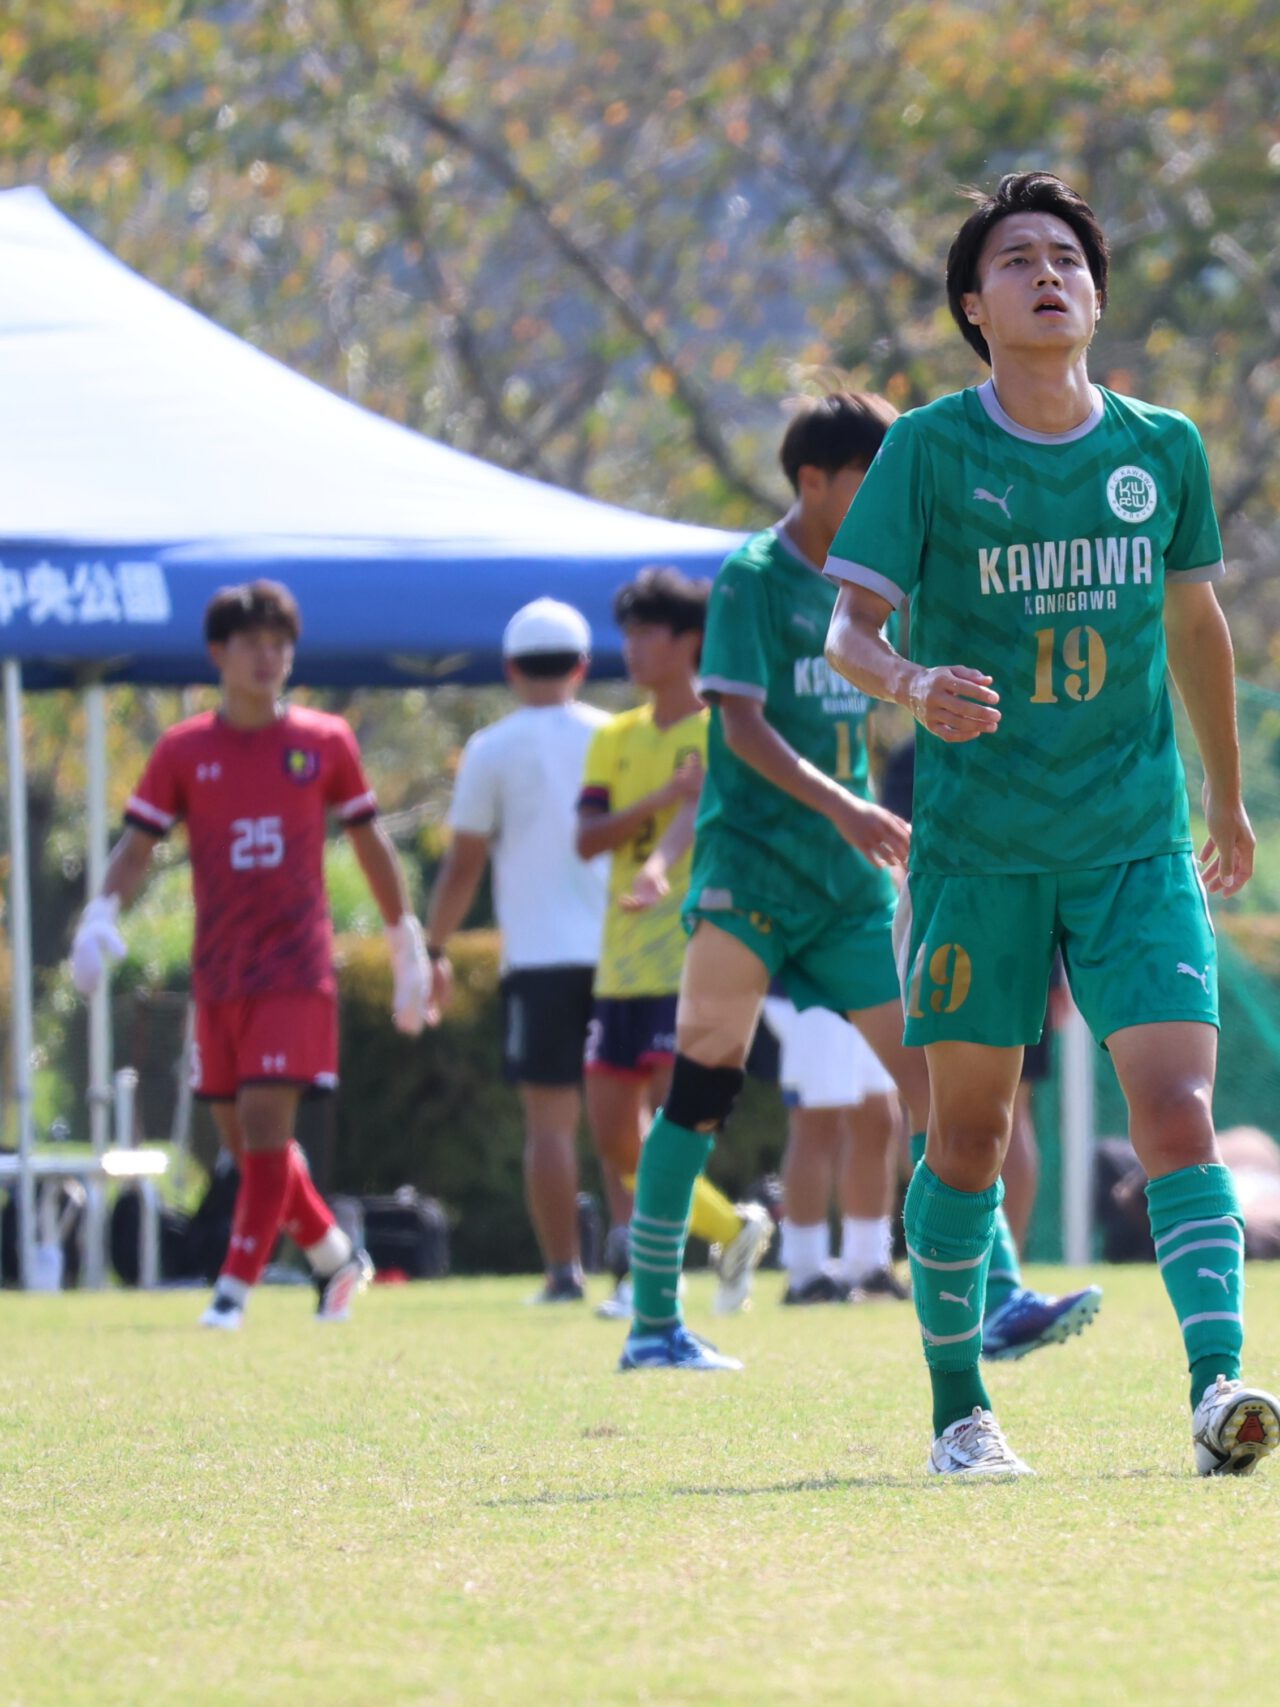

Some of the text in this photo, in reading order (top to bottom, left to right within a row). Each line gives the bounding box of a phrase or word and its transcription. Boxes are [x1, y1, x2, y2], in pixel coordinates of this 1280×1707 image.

[978, 536, 1152, 595] KAWAWA
[1024, 589, 1117, 616] KANAGAWA
[1030, 625, 1107, 704] 19
[230, 816, 285, 870] 25
[905, 943, 972, 1019] 19
